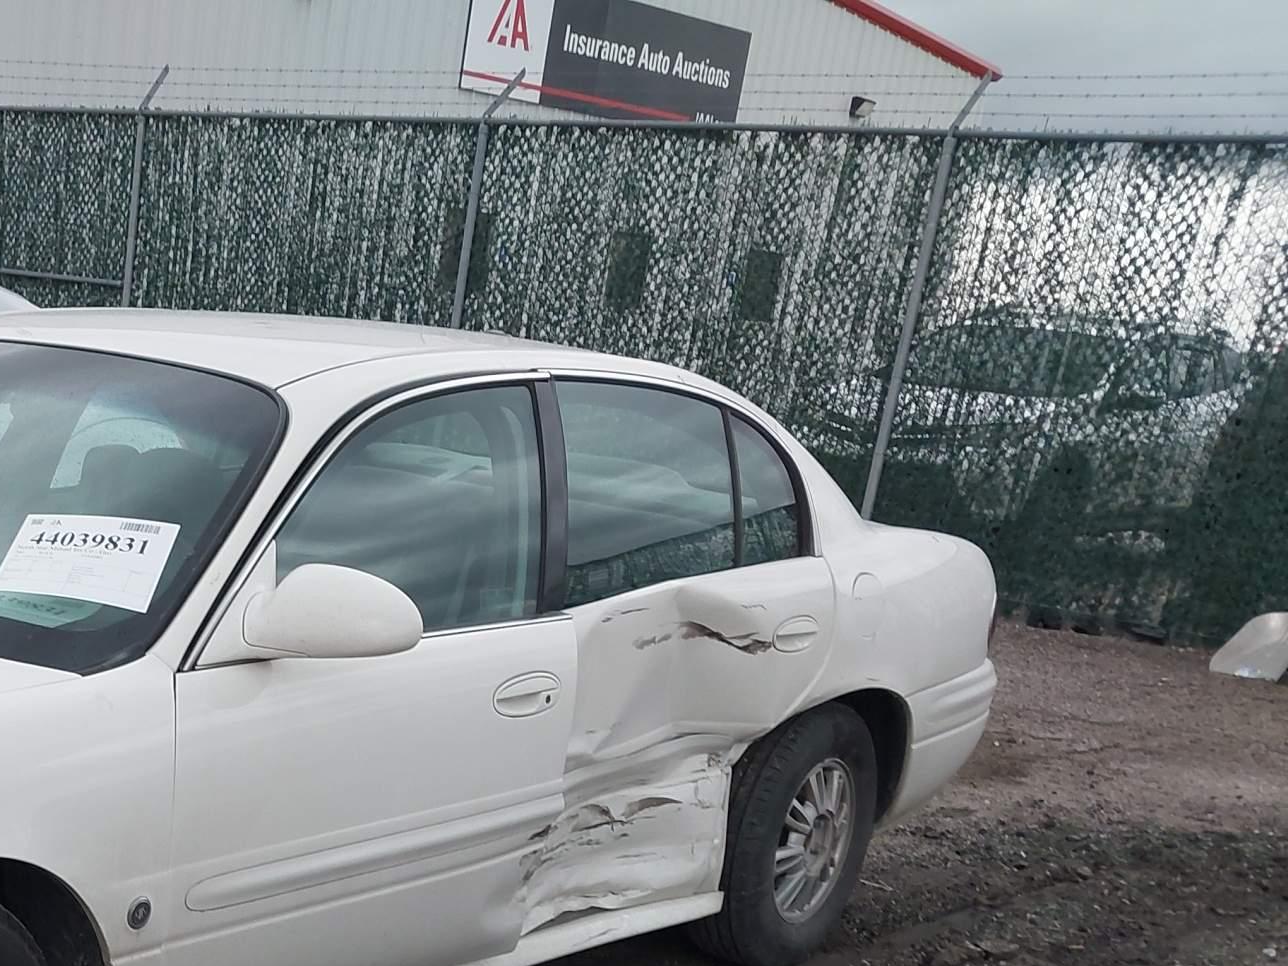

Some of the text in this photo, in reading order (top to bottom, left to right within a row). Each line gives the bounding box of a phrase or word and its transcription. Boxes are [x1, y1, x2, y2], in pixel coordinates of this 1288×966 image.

[563, 24, 731, 89] Insurance Auto Auctions
[30, 531, 148, 554] 44039831
